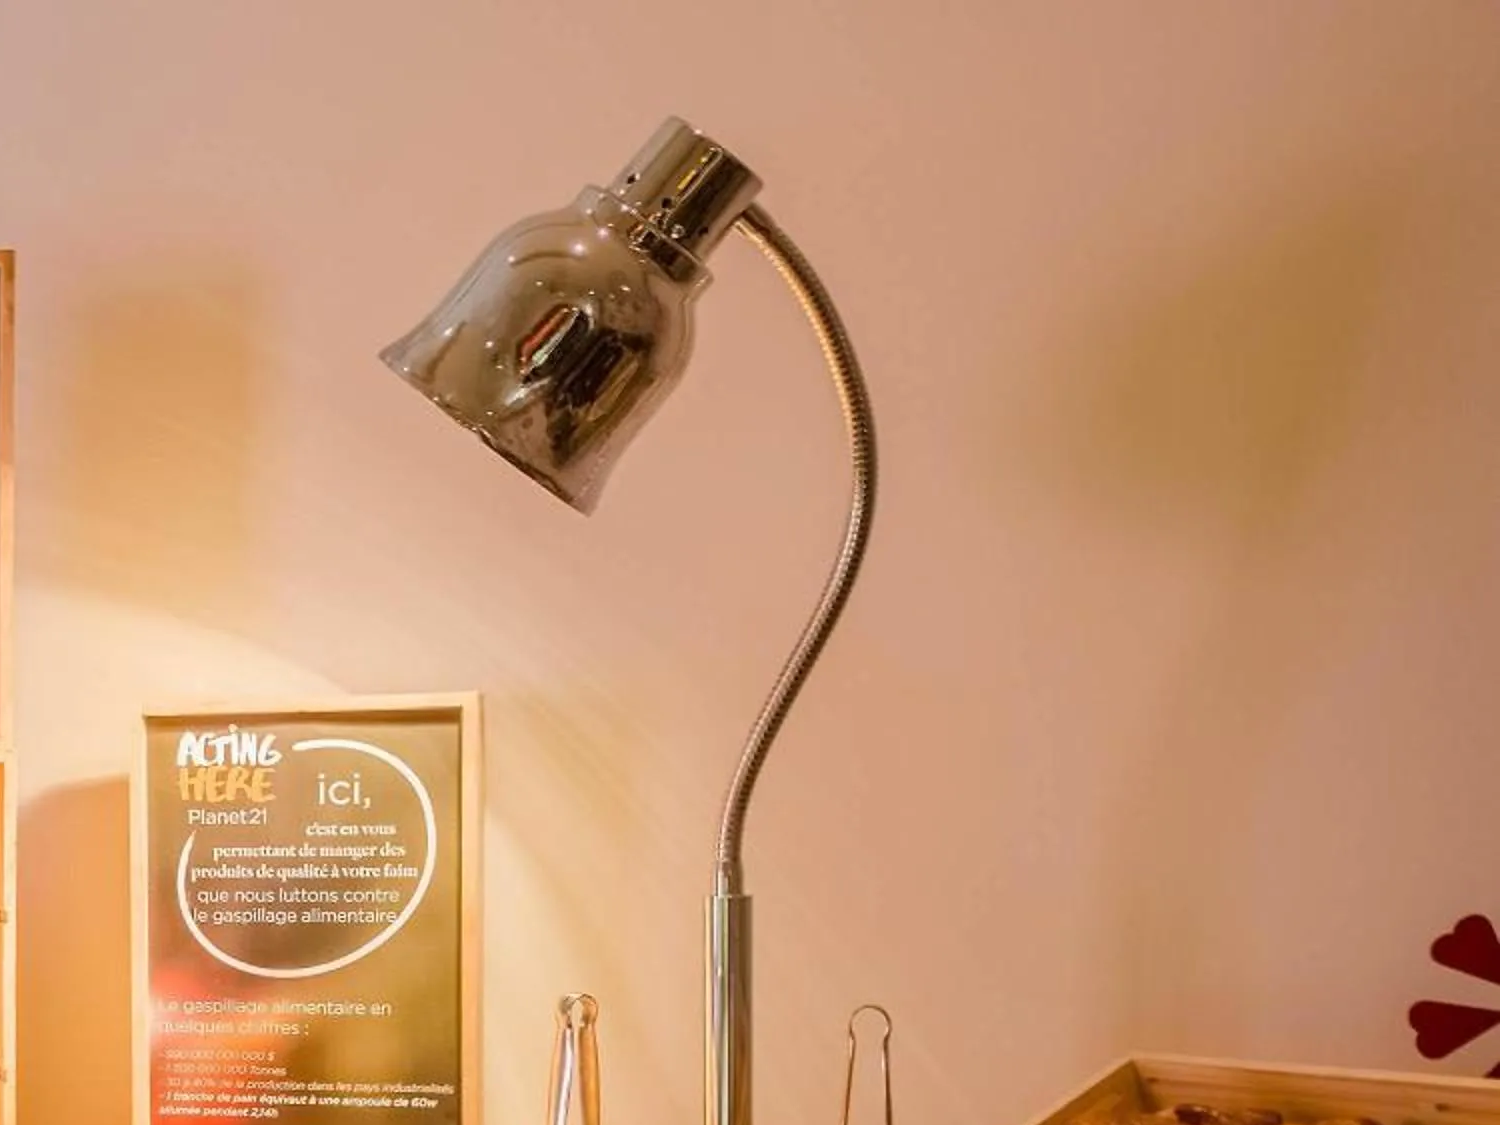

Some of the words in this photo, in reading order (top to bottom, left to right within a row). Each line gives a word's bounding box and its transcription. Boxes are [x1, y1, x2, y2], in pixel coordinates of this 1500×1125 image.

[176, 766, 277, 802] HERE
[317, 773, 371, 808] ici,
[340, 825, 359, 836] en
[361, 825, 396, 836] vous
[213, 845, 297, 861] permettant
[298, 844, 315, 857] de
[319, 847, 378, 861] manger
[379, 842, 407, 857] des
[191, 864, 254, 882] produits
[256, 864, 275, 878] de
[277, 864, 328, 882] qualité
[330, 864, 339, 878] à
[341, 866, 380, 878] votre
[197, 890, 228, 906] que
[235, 890, 274, 903] nous
[279, 888, 339, 903] luttons
[343, 889, 400, 903] contre
[193, 907, 208, 923] le
[212, 907, 297, 925] gaspillage
[371, 1003, 392, 1016] en
